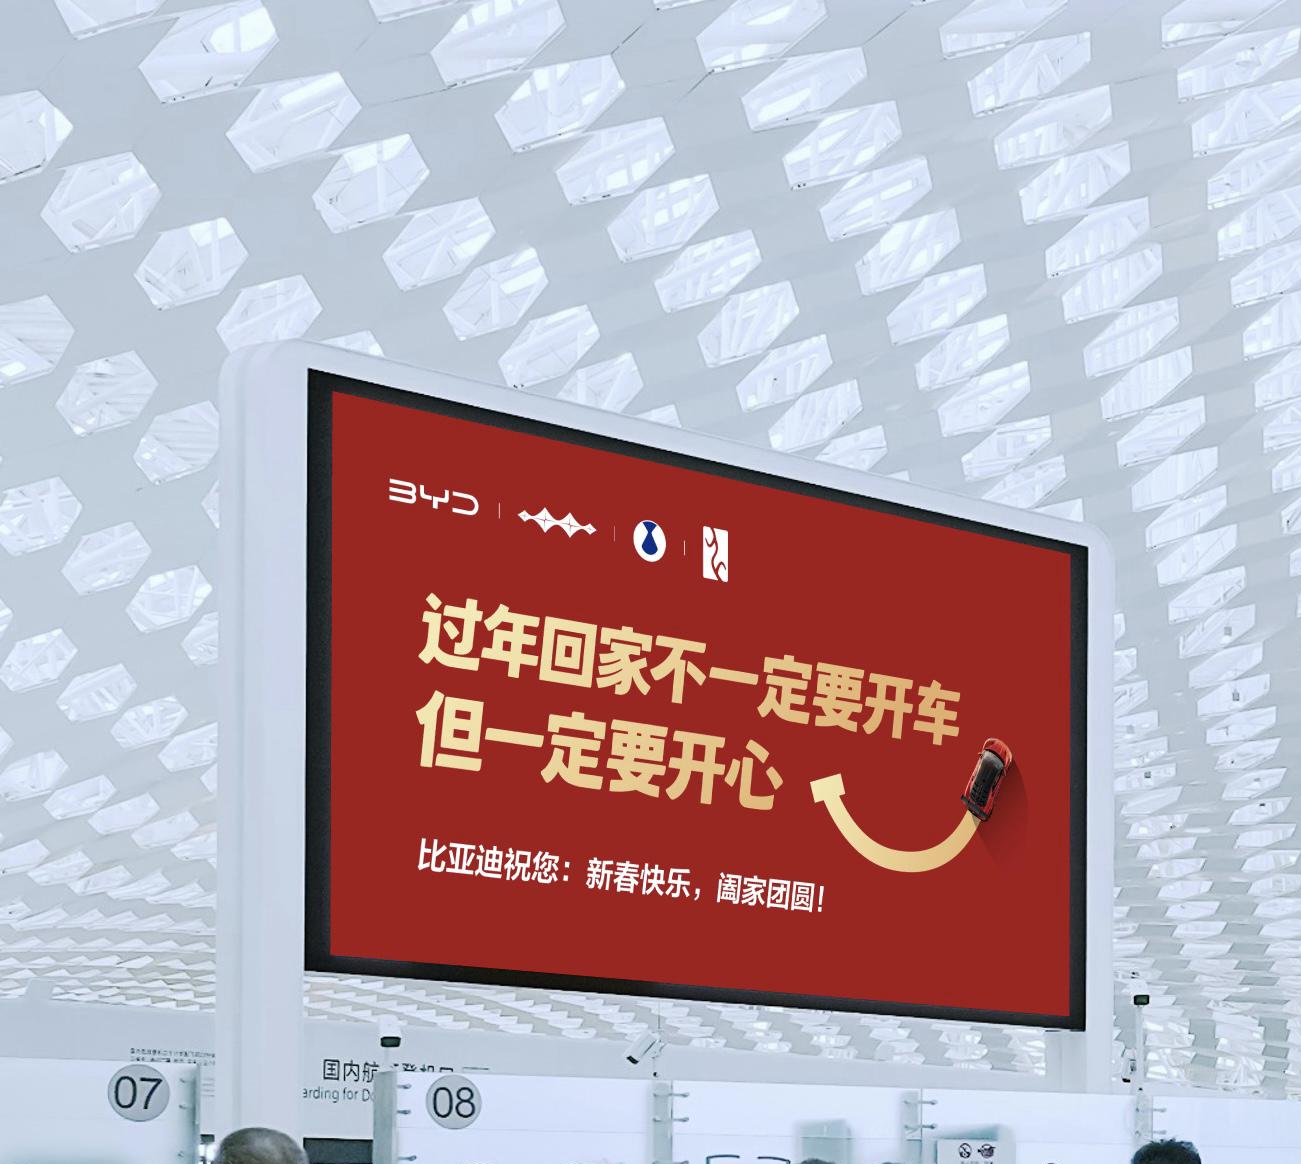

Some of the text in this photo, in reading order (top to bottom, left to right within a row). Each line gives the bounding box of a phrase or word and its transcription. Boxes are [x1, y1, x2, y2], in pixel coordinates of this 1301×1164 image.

[389, 478, 479, 515] BYD
[418, 593, 960, 745] 过年回家不一定要开车
[416, 690, 783, 810] 但一定要开心
[114, 1076, 162, 1110] 07
[343, 1088, 358, 1100] for
[433, 1087, 476, 1118] 08
